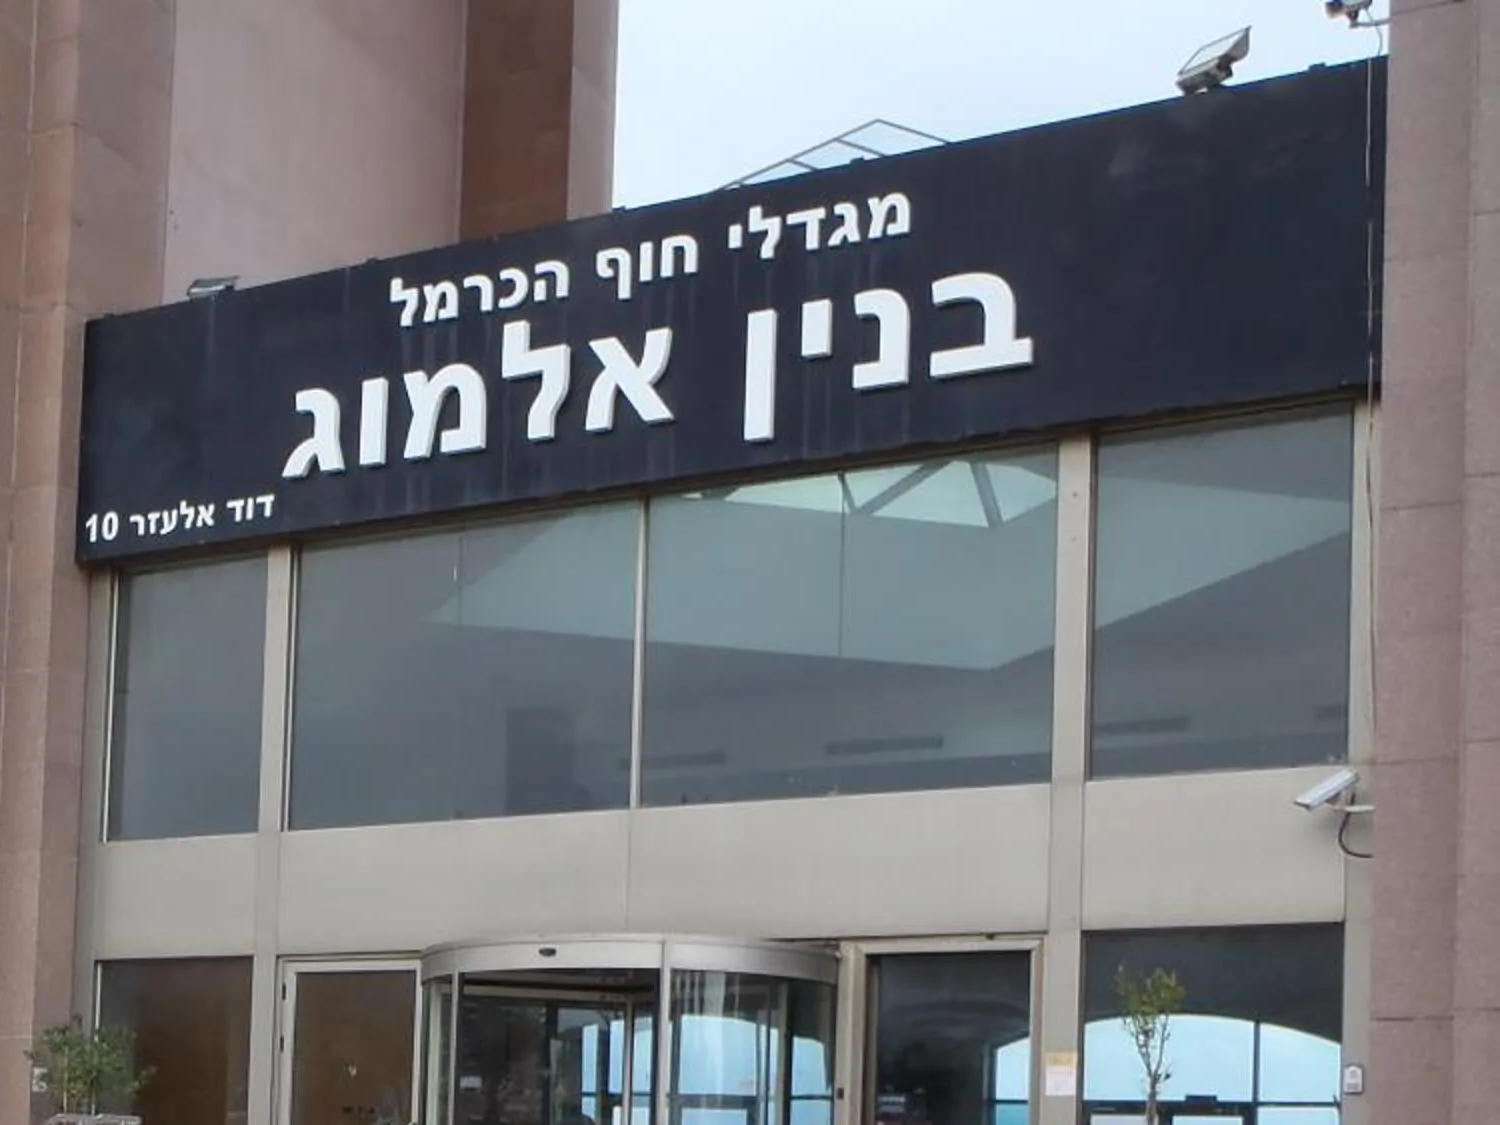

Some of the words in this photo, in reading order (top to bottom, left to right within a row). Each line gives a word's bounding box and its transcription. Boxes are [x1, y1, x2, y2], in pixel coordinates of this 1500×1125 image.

[728, 192, 911, 259] מגדלי
[389, 260, 571, 327] הכרמל
[596, 234, 699, 300] חוף
[743, 272, 1034, 442] בנין
[281, 319, 675, 479] אלמוג
[85, 511, 120, 544] 10
[129, 500, 216, 536] אלעזר
[226, 493, 276, 523] דוד
